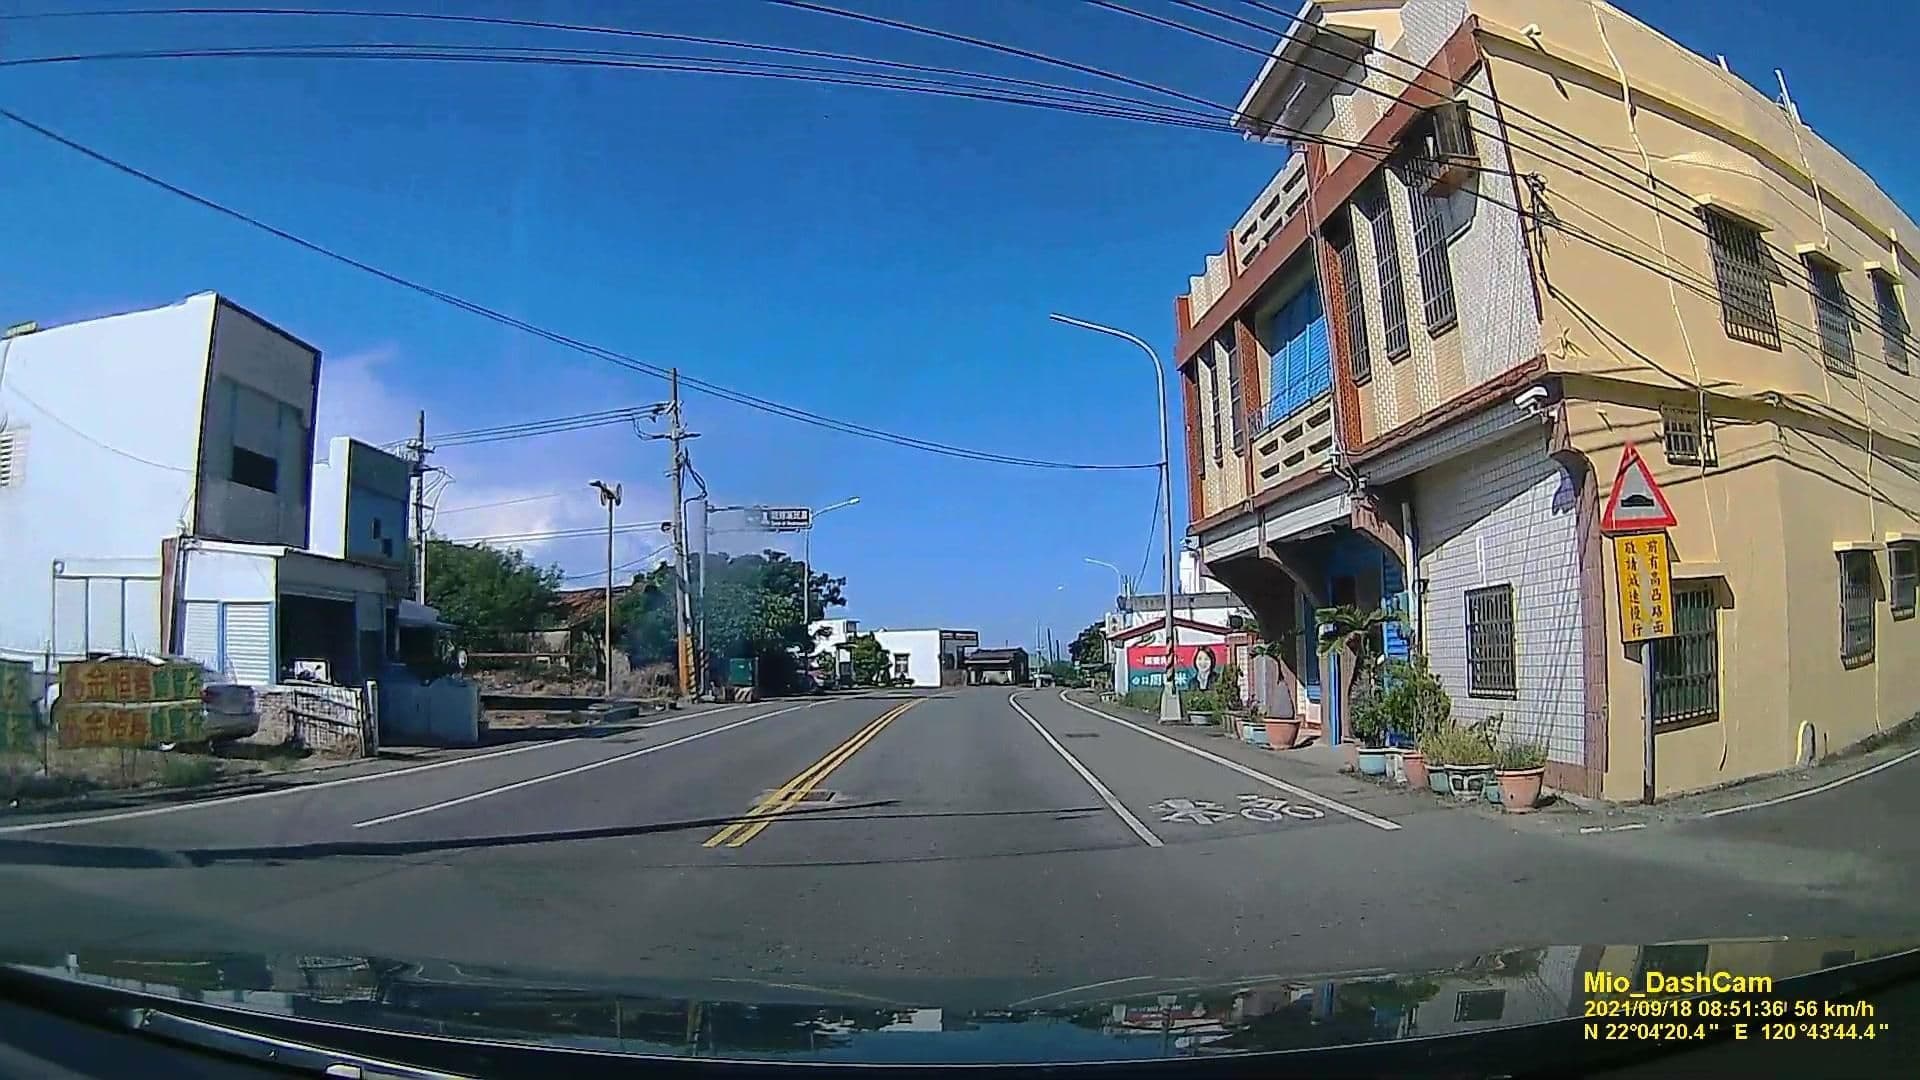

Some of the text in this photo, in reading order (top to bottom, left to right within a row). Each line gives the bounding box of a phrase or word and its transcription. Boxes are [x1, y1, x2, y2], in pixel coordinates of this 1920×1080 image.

[1624, 540, 1643, 637] 敬請減速慢行
[1646, 538, 1664, 633] 前有高凸路面
